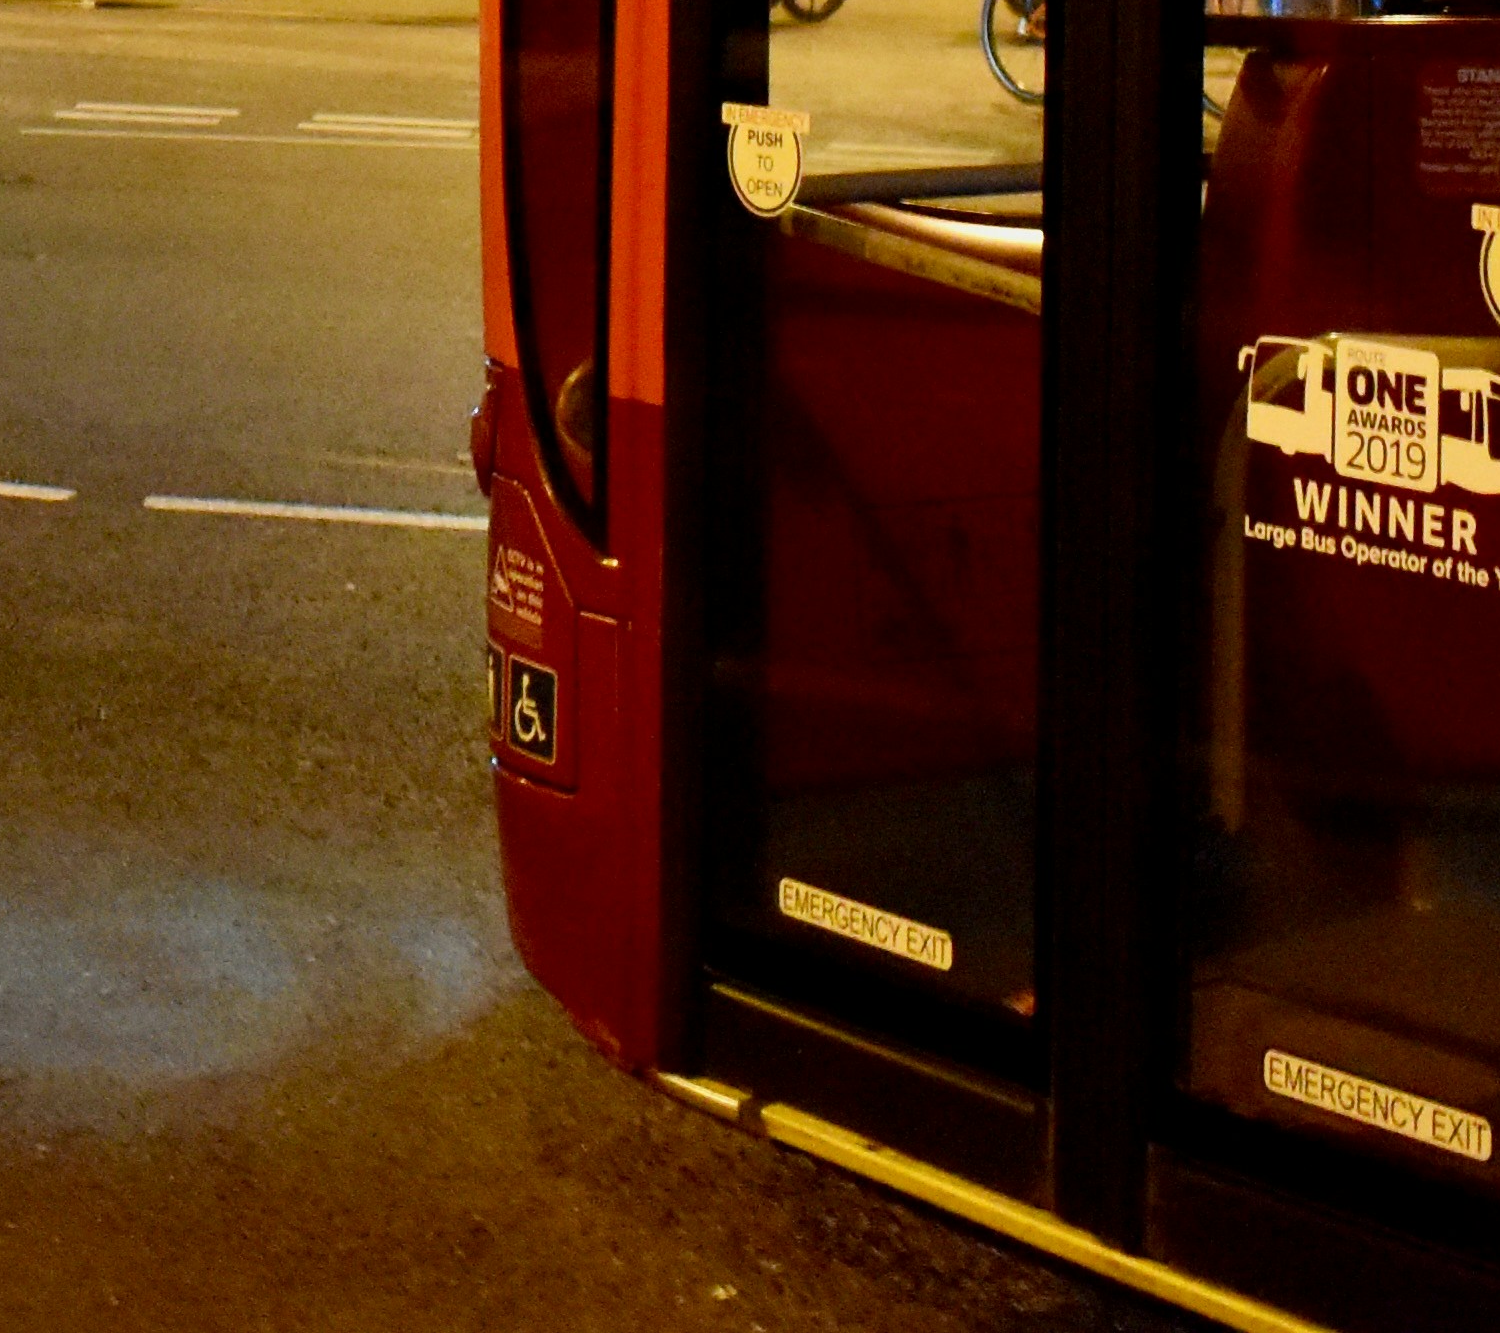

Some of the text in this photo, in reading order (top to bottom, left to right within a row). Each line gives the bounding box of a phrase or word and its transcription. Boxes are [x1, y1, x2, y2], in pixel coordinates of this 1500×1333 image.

[747, 129, 783, 148] PUSH
[757, 154, 774, 172] TO
[746, 178, 783, 198] OPEN
[1346, 366, 1428, 416] ONE
[1346, 408, 1427, 440] AWARDS
[1345, 431, 1427, 481] 2019
[1293, 477, 1478, 555] WINNER
[1244, 514, 1297, 549] Large
[1301, 526, 1336, 555] Bus
[1341, 537, 1428, 574] Operator
[1432, 556, 1453, 580] of
[1456, 559, 1489, 588] the
[783, 884, 947, 964] EMERGENCY EXIT
[1268, 1056, 1487, 1155] EMERGENCY EXIT
